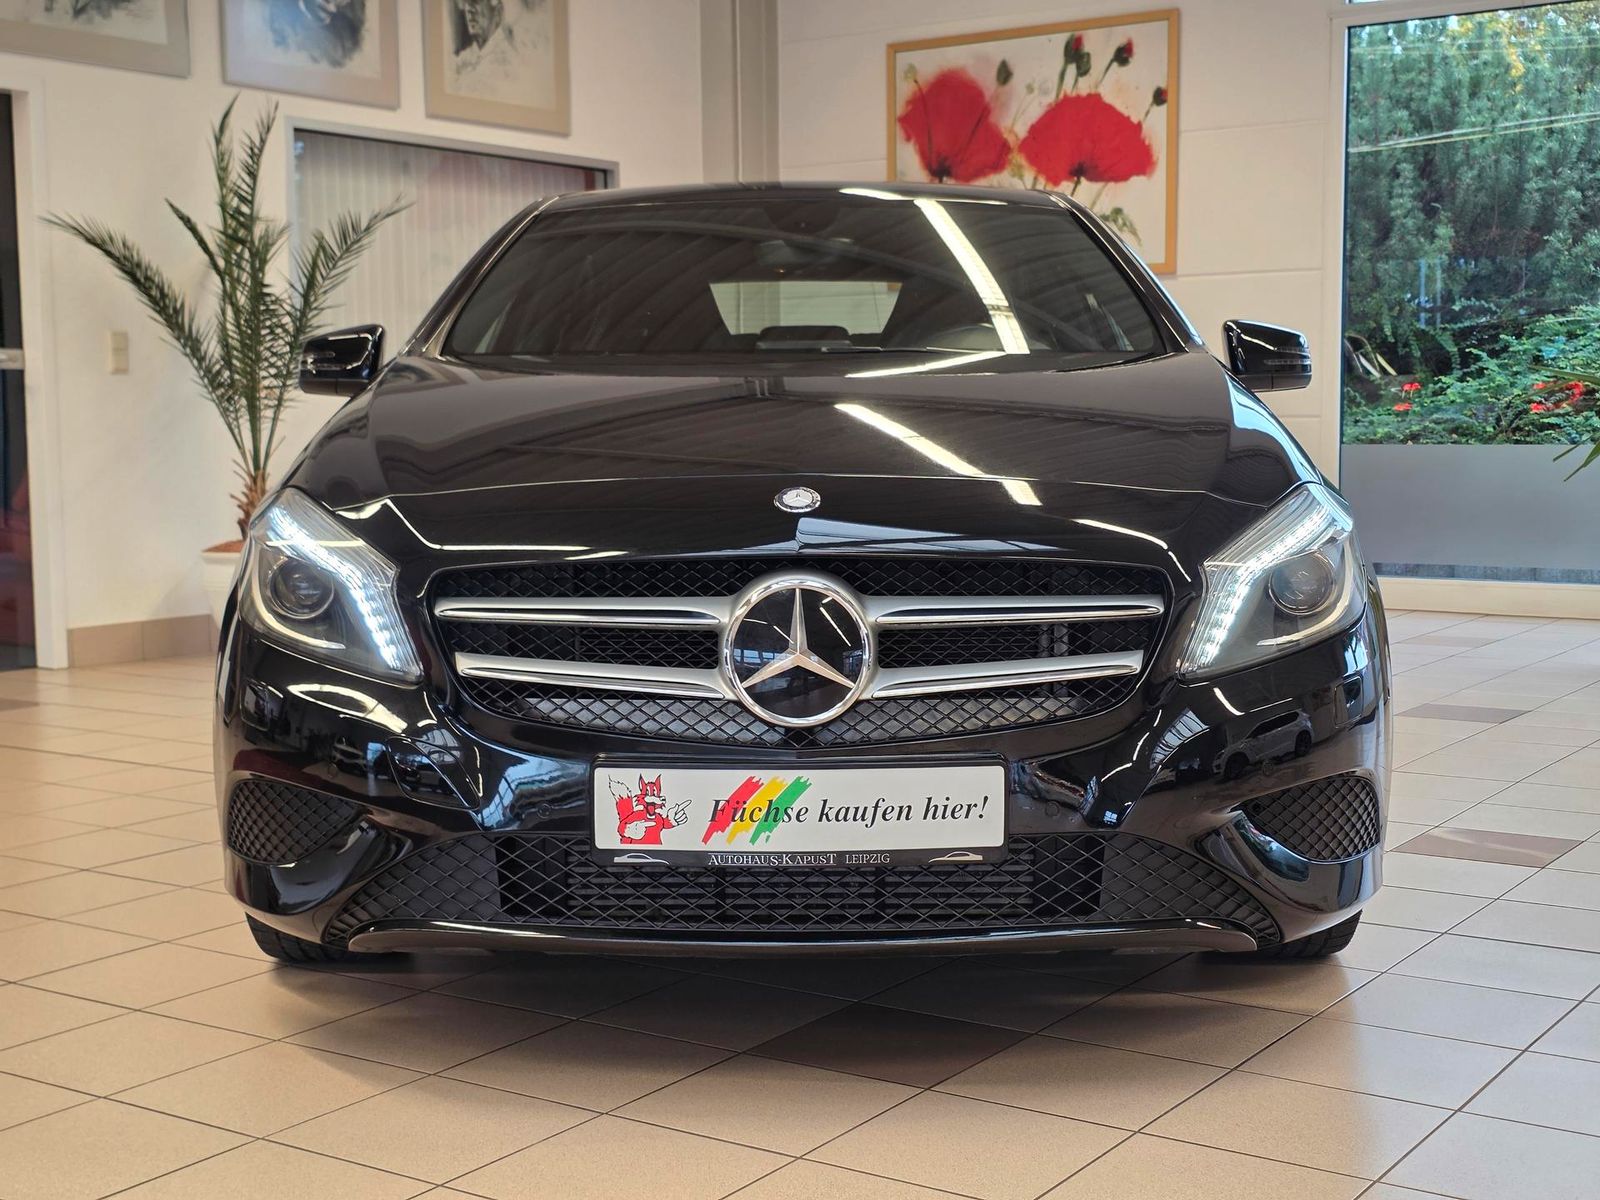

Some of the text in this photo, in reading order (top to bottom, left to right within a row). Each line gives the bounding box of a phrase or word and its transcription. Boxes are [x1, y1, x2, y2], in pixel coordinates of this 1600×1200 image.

[708, 796, 989, 828] Füchse kaufen hier!
[845, 854, 890, 864] LEIPZIG
